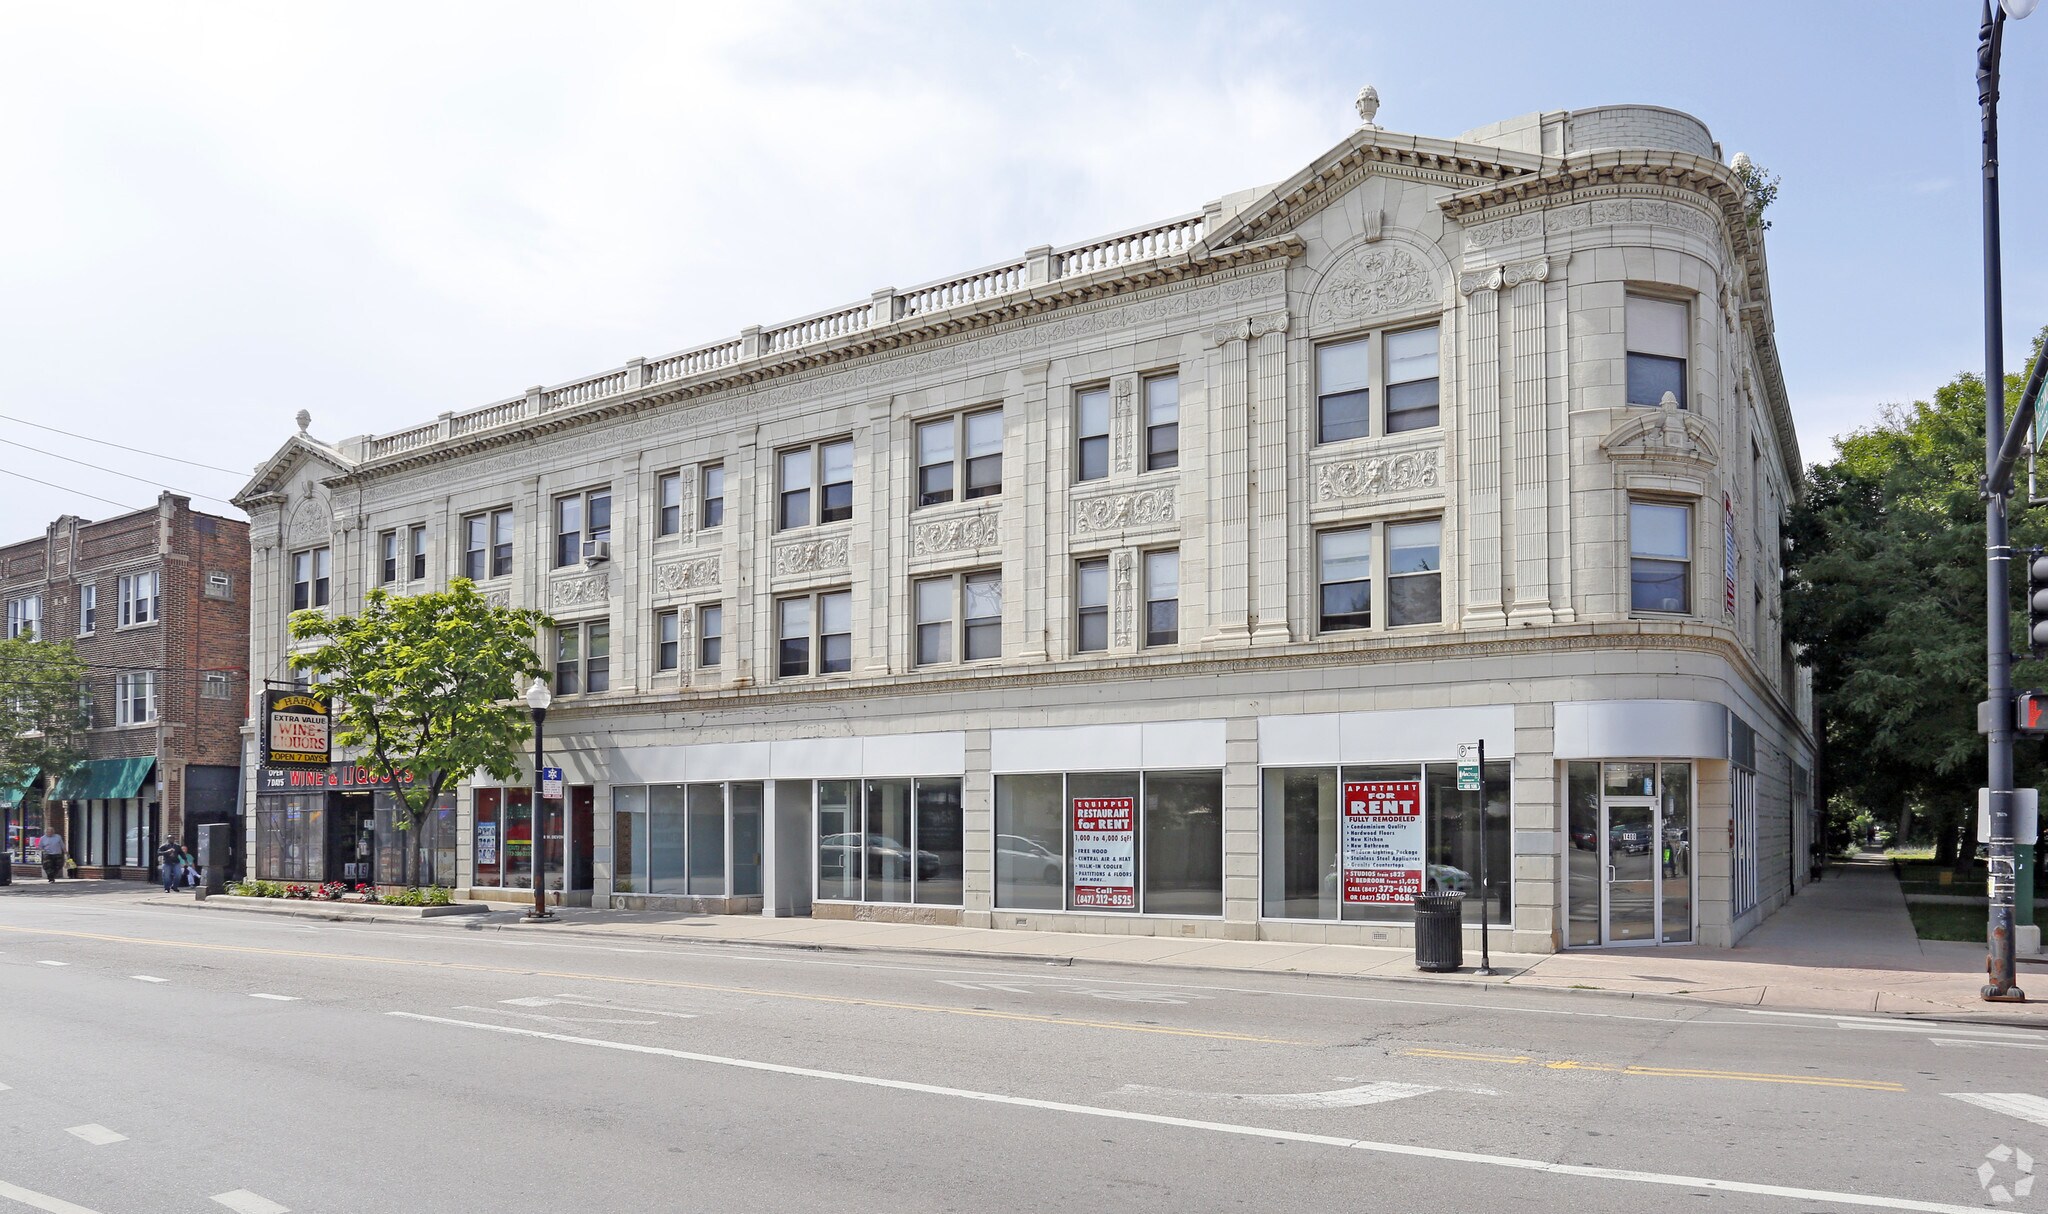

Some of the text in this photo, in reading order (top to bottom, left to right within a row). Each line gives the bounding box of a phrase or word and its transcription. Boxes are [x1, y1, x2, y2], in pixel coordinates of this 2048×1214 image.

[285, 697, 317, 707] HAHN
[290, 771, 324, 787] WINE
[328, 773, 338, 785] &
[1351, 800, 1414, 814] RENT
[1078, 809, 1129, 818] RESTAURANT
[1078, 819, 1129, 829] for RENT
[1077, 895, 1131, 904] (847) 212-8525
